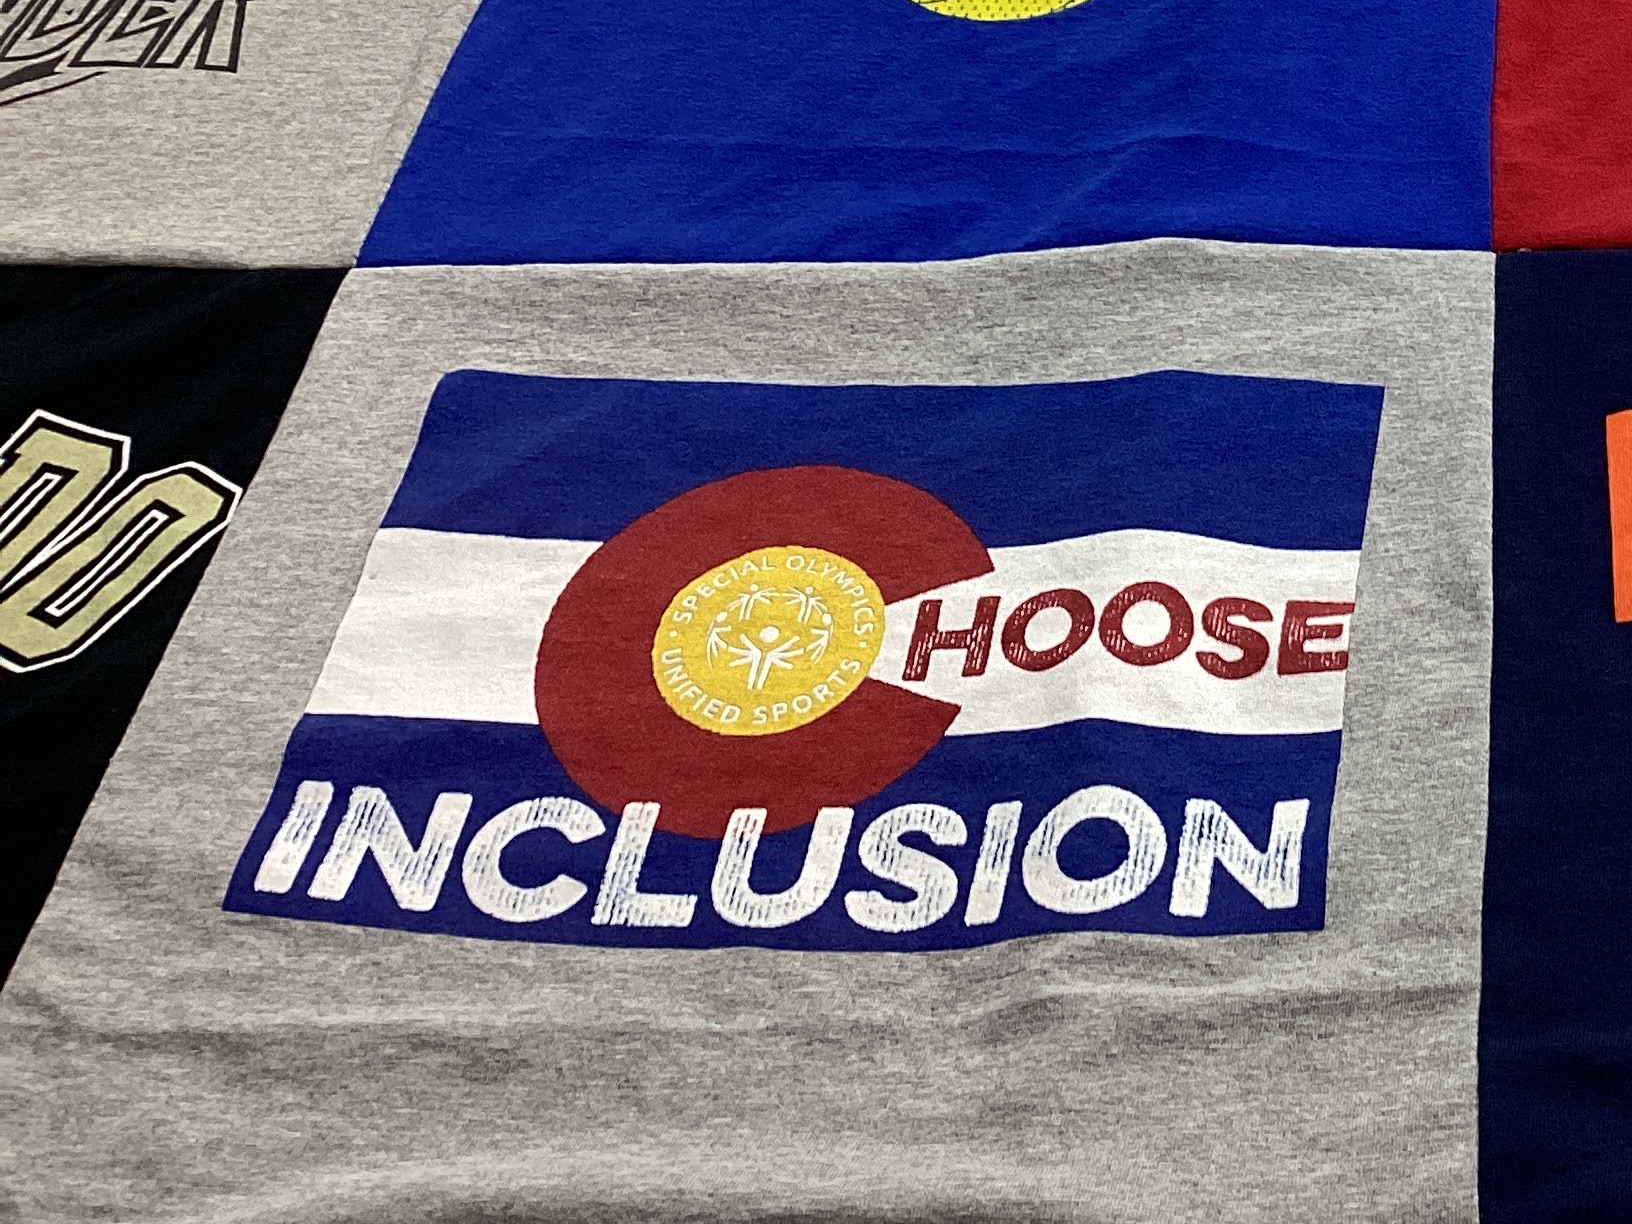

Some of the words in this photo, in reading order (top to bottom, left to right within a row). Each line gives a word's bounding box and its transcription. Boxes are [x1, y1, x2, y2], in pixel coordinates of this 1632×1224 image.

[672, 555, 777, 624] SPECIAL
[785, 555, 875, 636] OLYMPICS
[660, 647, 742, 724] UNIFIED
[752, 658, 862, 725] SPORTS
[253, 779, 1310, 934] INCLUSION
